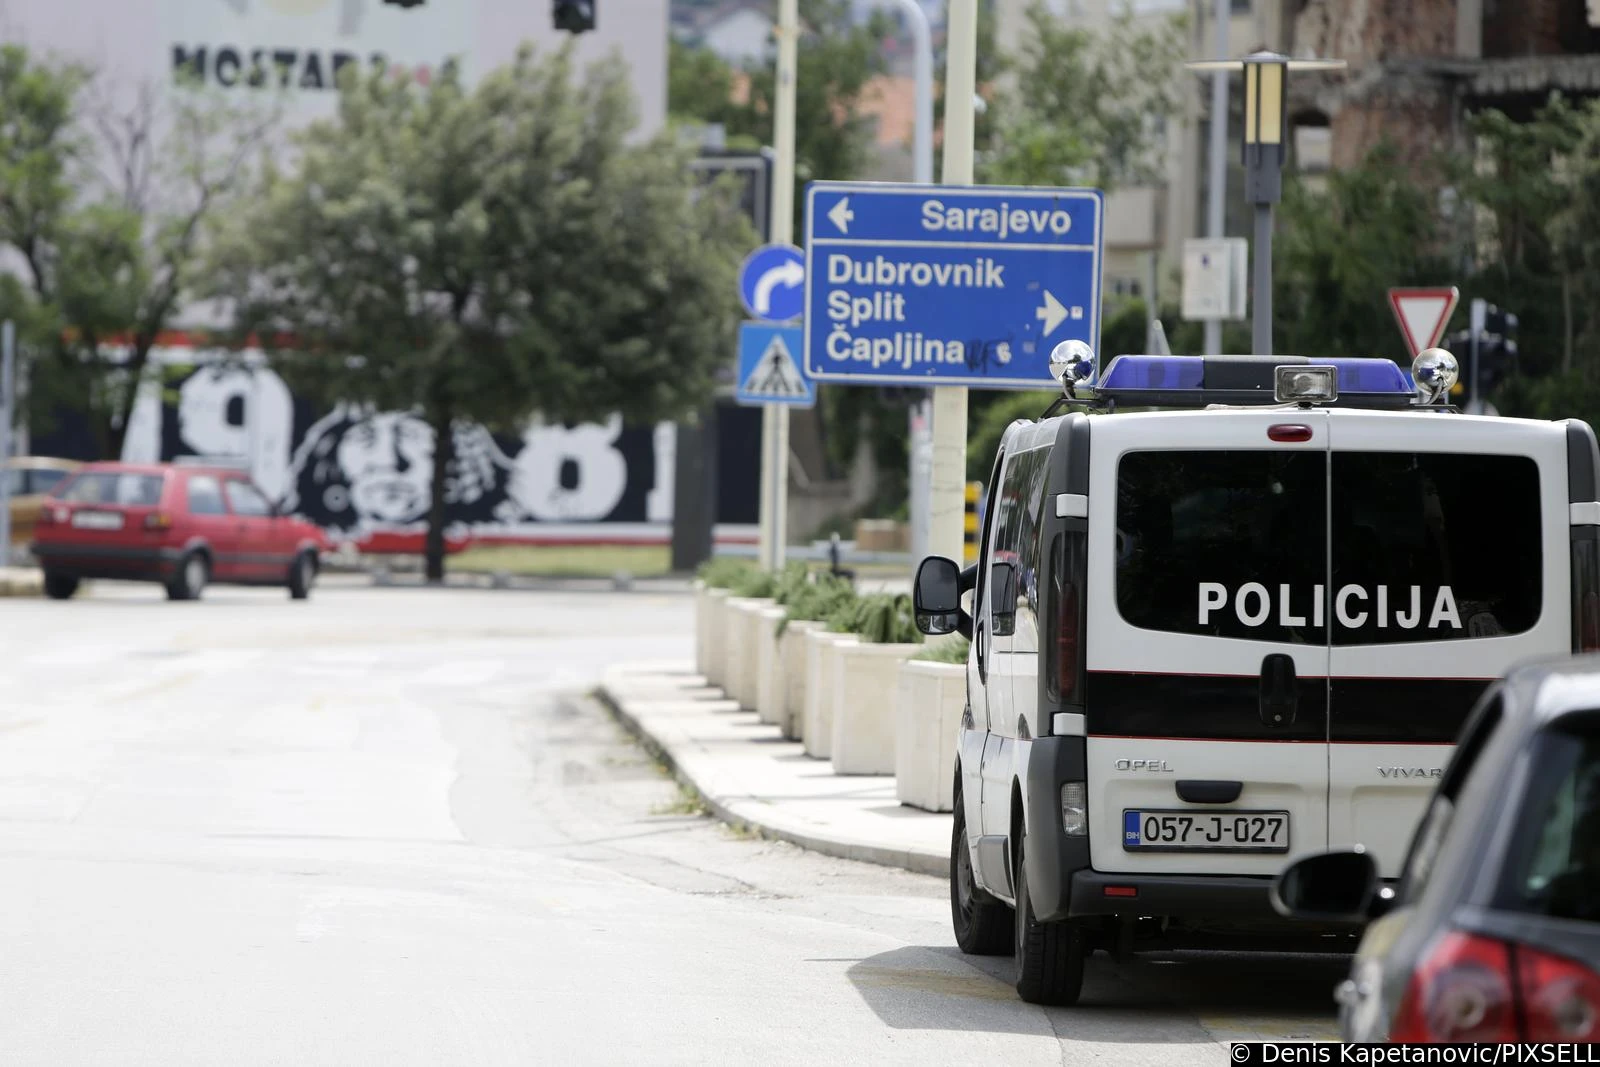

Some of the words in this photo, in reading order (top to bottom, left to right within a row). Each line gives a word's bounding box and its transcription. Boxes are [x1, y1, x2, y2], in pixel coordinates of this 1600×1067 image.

[921, 199, 1072, 239] Sarajevo
[827, 253, 1006, 289] Dubrovnik
[827, 289, 906, 328] Split
[826, 322, 965, 370] Čapljina
[1198, 581, 1463, 629] POLICIJA
[1114, 758, 1174, 772] OPEL
[1376, 766, 1447, 778] VIVAR
[1144, 816, 1283, 843] 057-J-027
